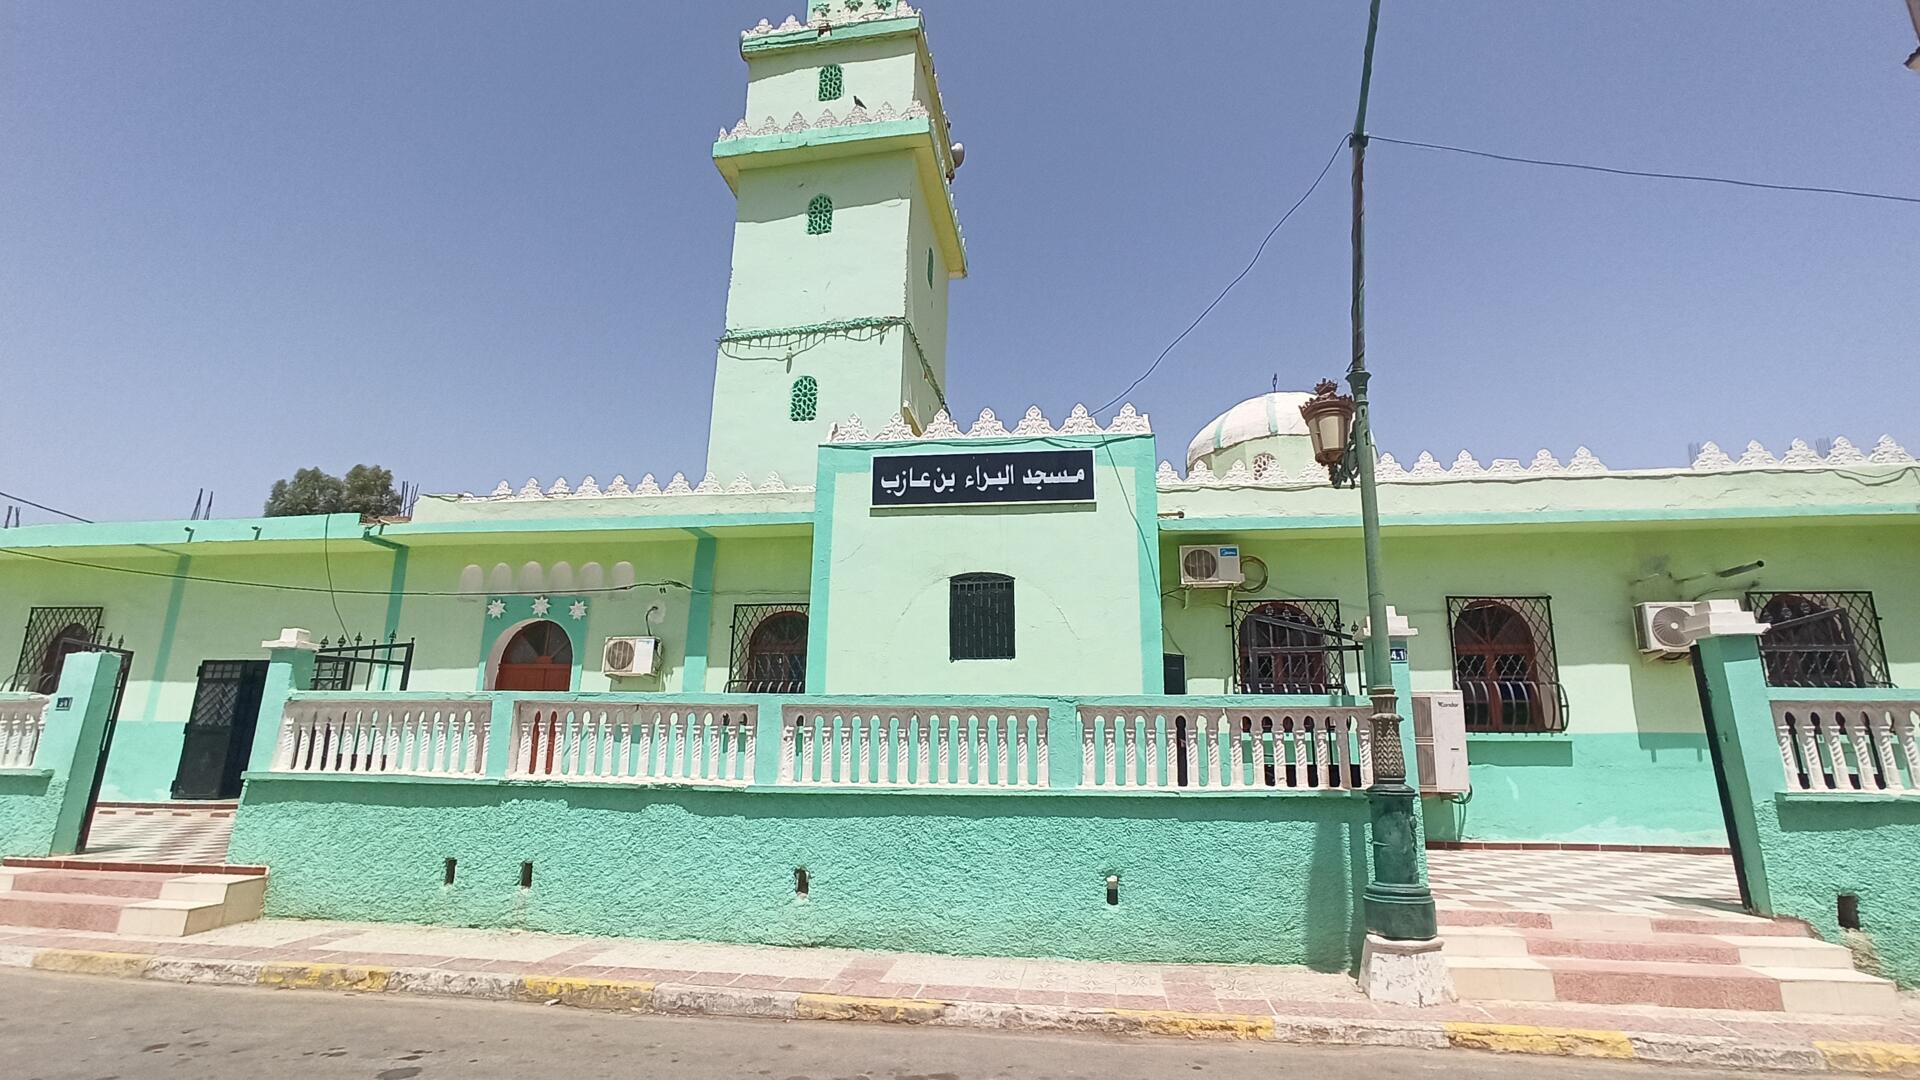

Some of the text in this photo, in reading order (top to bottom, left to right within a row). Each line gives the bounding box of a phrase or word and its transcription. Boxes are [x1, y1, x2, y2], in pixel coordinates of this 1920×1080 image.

[880, 463, 1086, 497] مسجد البراء بن عازب
